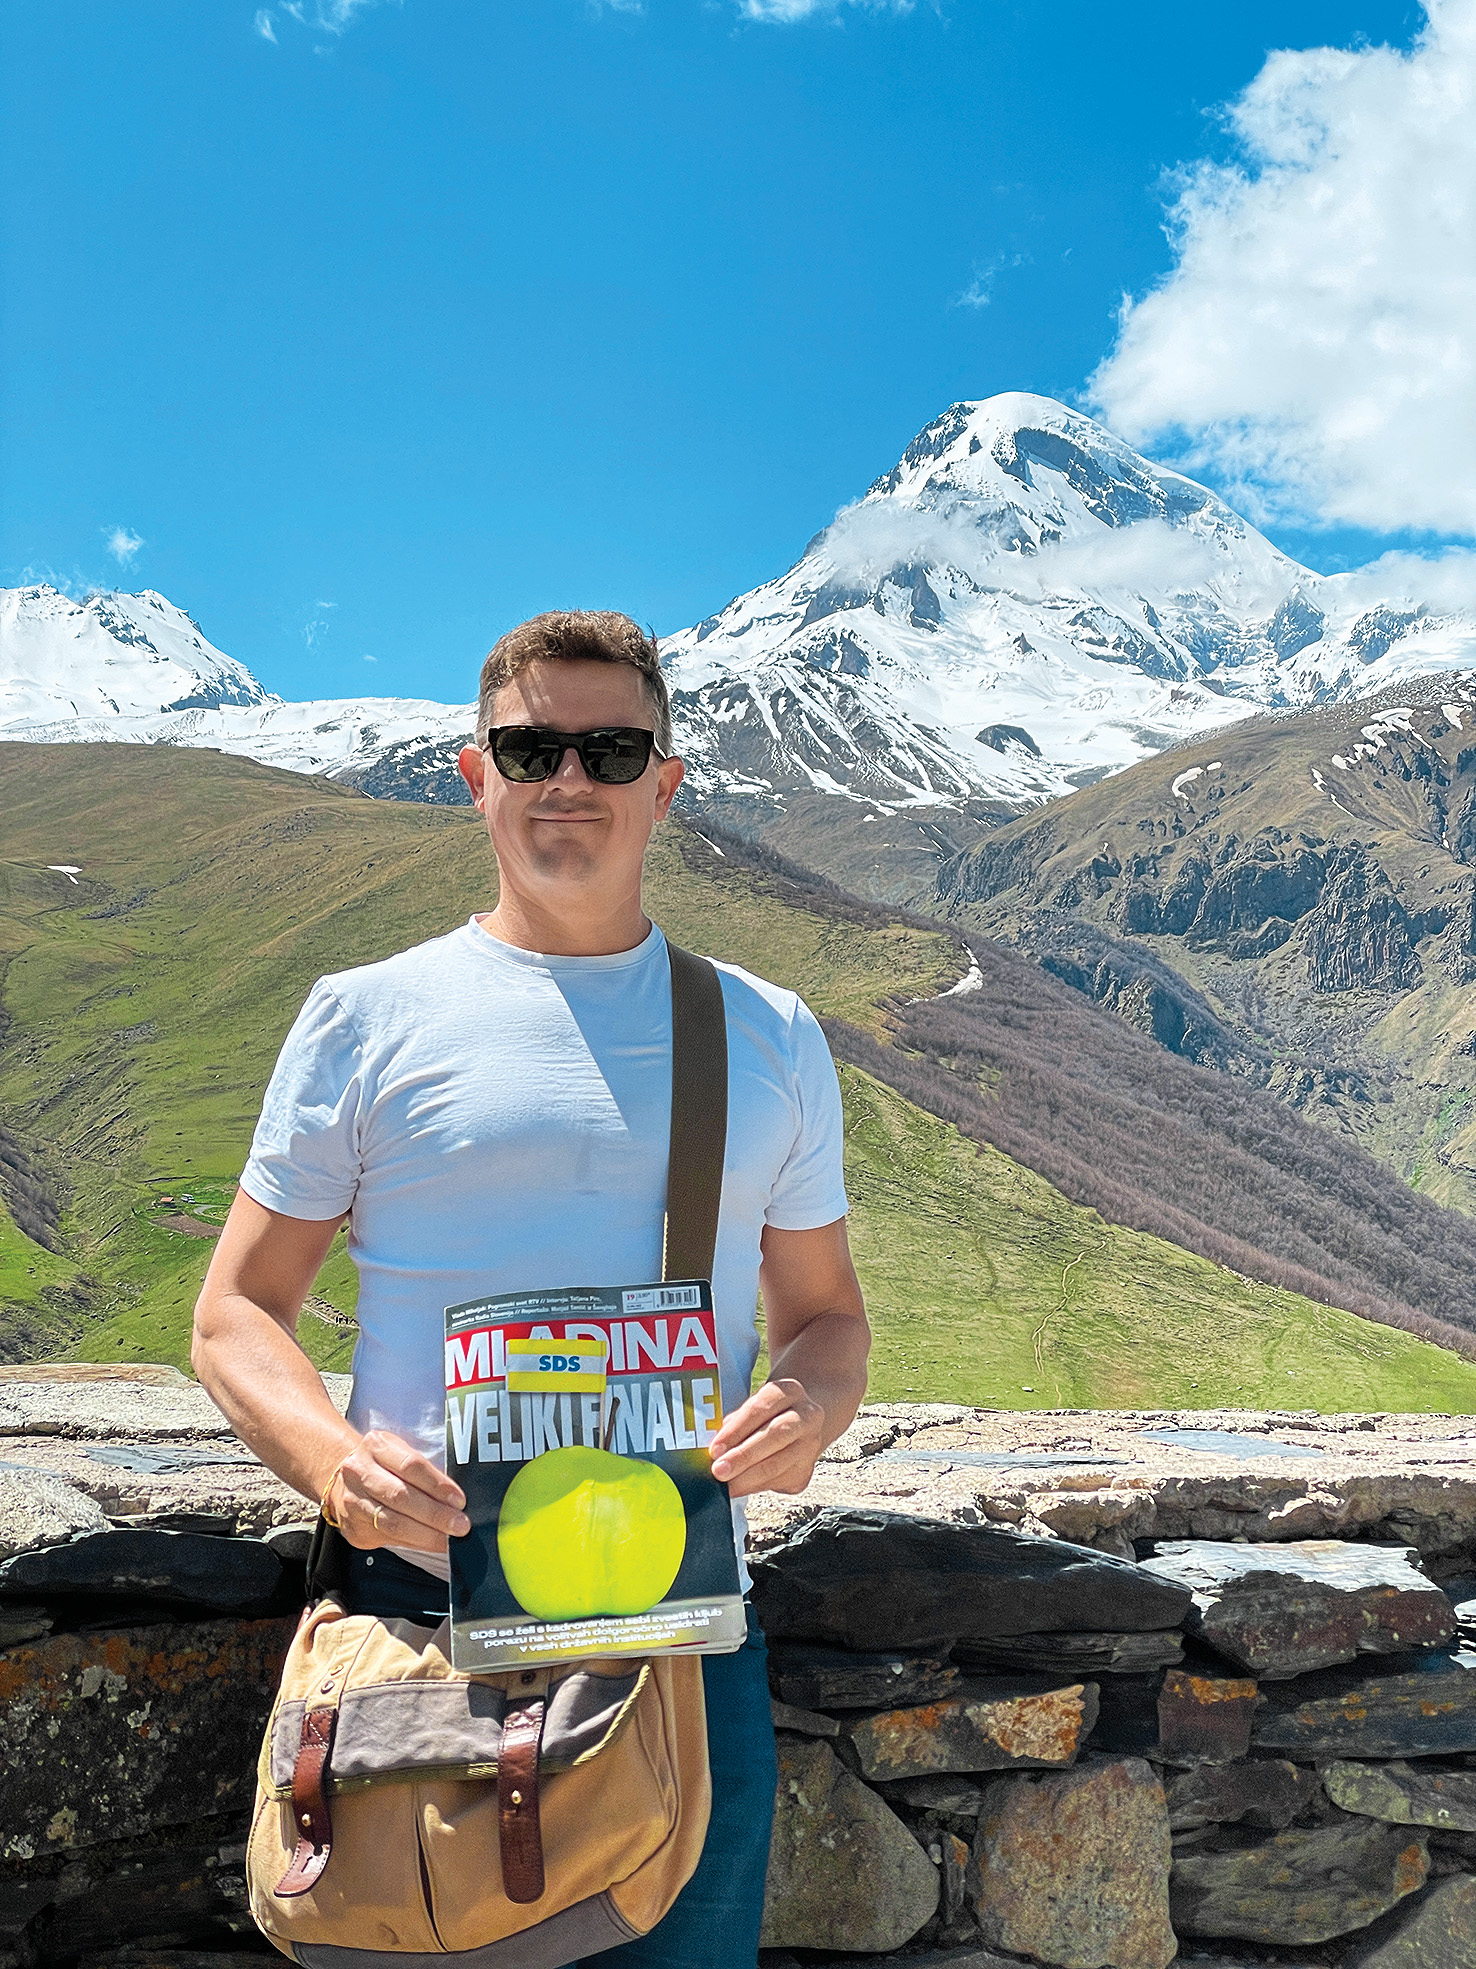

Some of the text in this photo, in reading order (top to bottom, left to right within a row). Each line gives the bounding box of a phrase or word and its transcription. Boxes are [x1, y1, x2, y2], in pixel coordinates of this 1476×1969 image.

[445, 1316, 718, 1387] MLDINA
[539, 1355, 580, 1372] SDS
[449, 1390, 574, 1464] VELIKI
[469, 1629, 498, 1640] SDS
[498, 1629, 514, 1637] se
[515, 1625, 536, 1635] želi
[546, 1618, 623, 1632] kadrovanjem
[625, 1616, 651, 1624] sebi
[651, 1611, 694, 1622] zvestih
[694, 1608, 723, 1618] kljub
[484, 1636, 527, 1649] porazu
[546, 1629, 591, 1641] volitvah
[592, 1624, 663, 1636] dolgoročno
[664, 1618, 710, 1629] usidrati
[529, 1643, 558, 1651] vseh
[560, 1637, 612, 1649] državnih
[613, 1631, 676, 1642] institucijah
